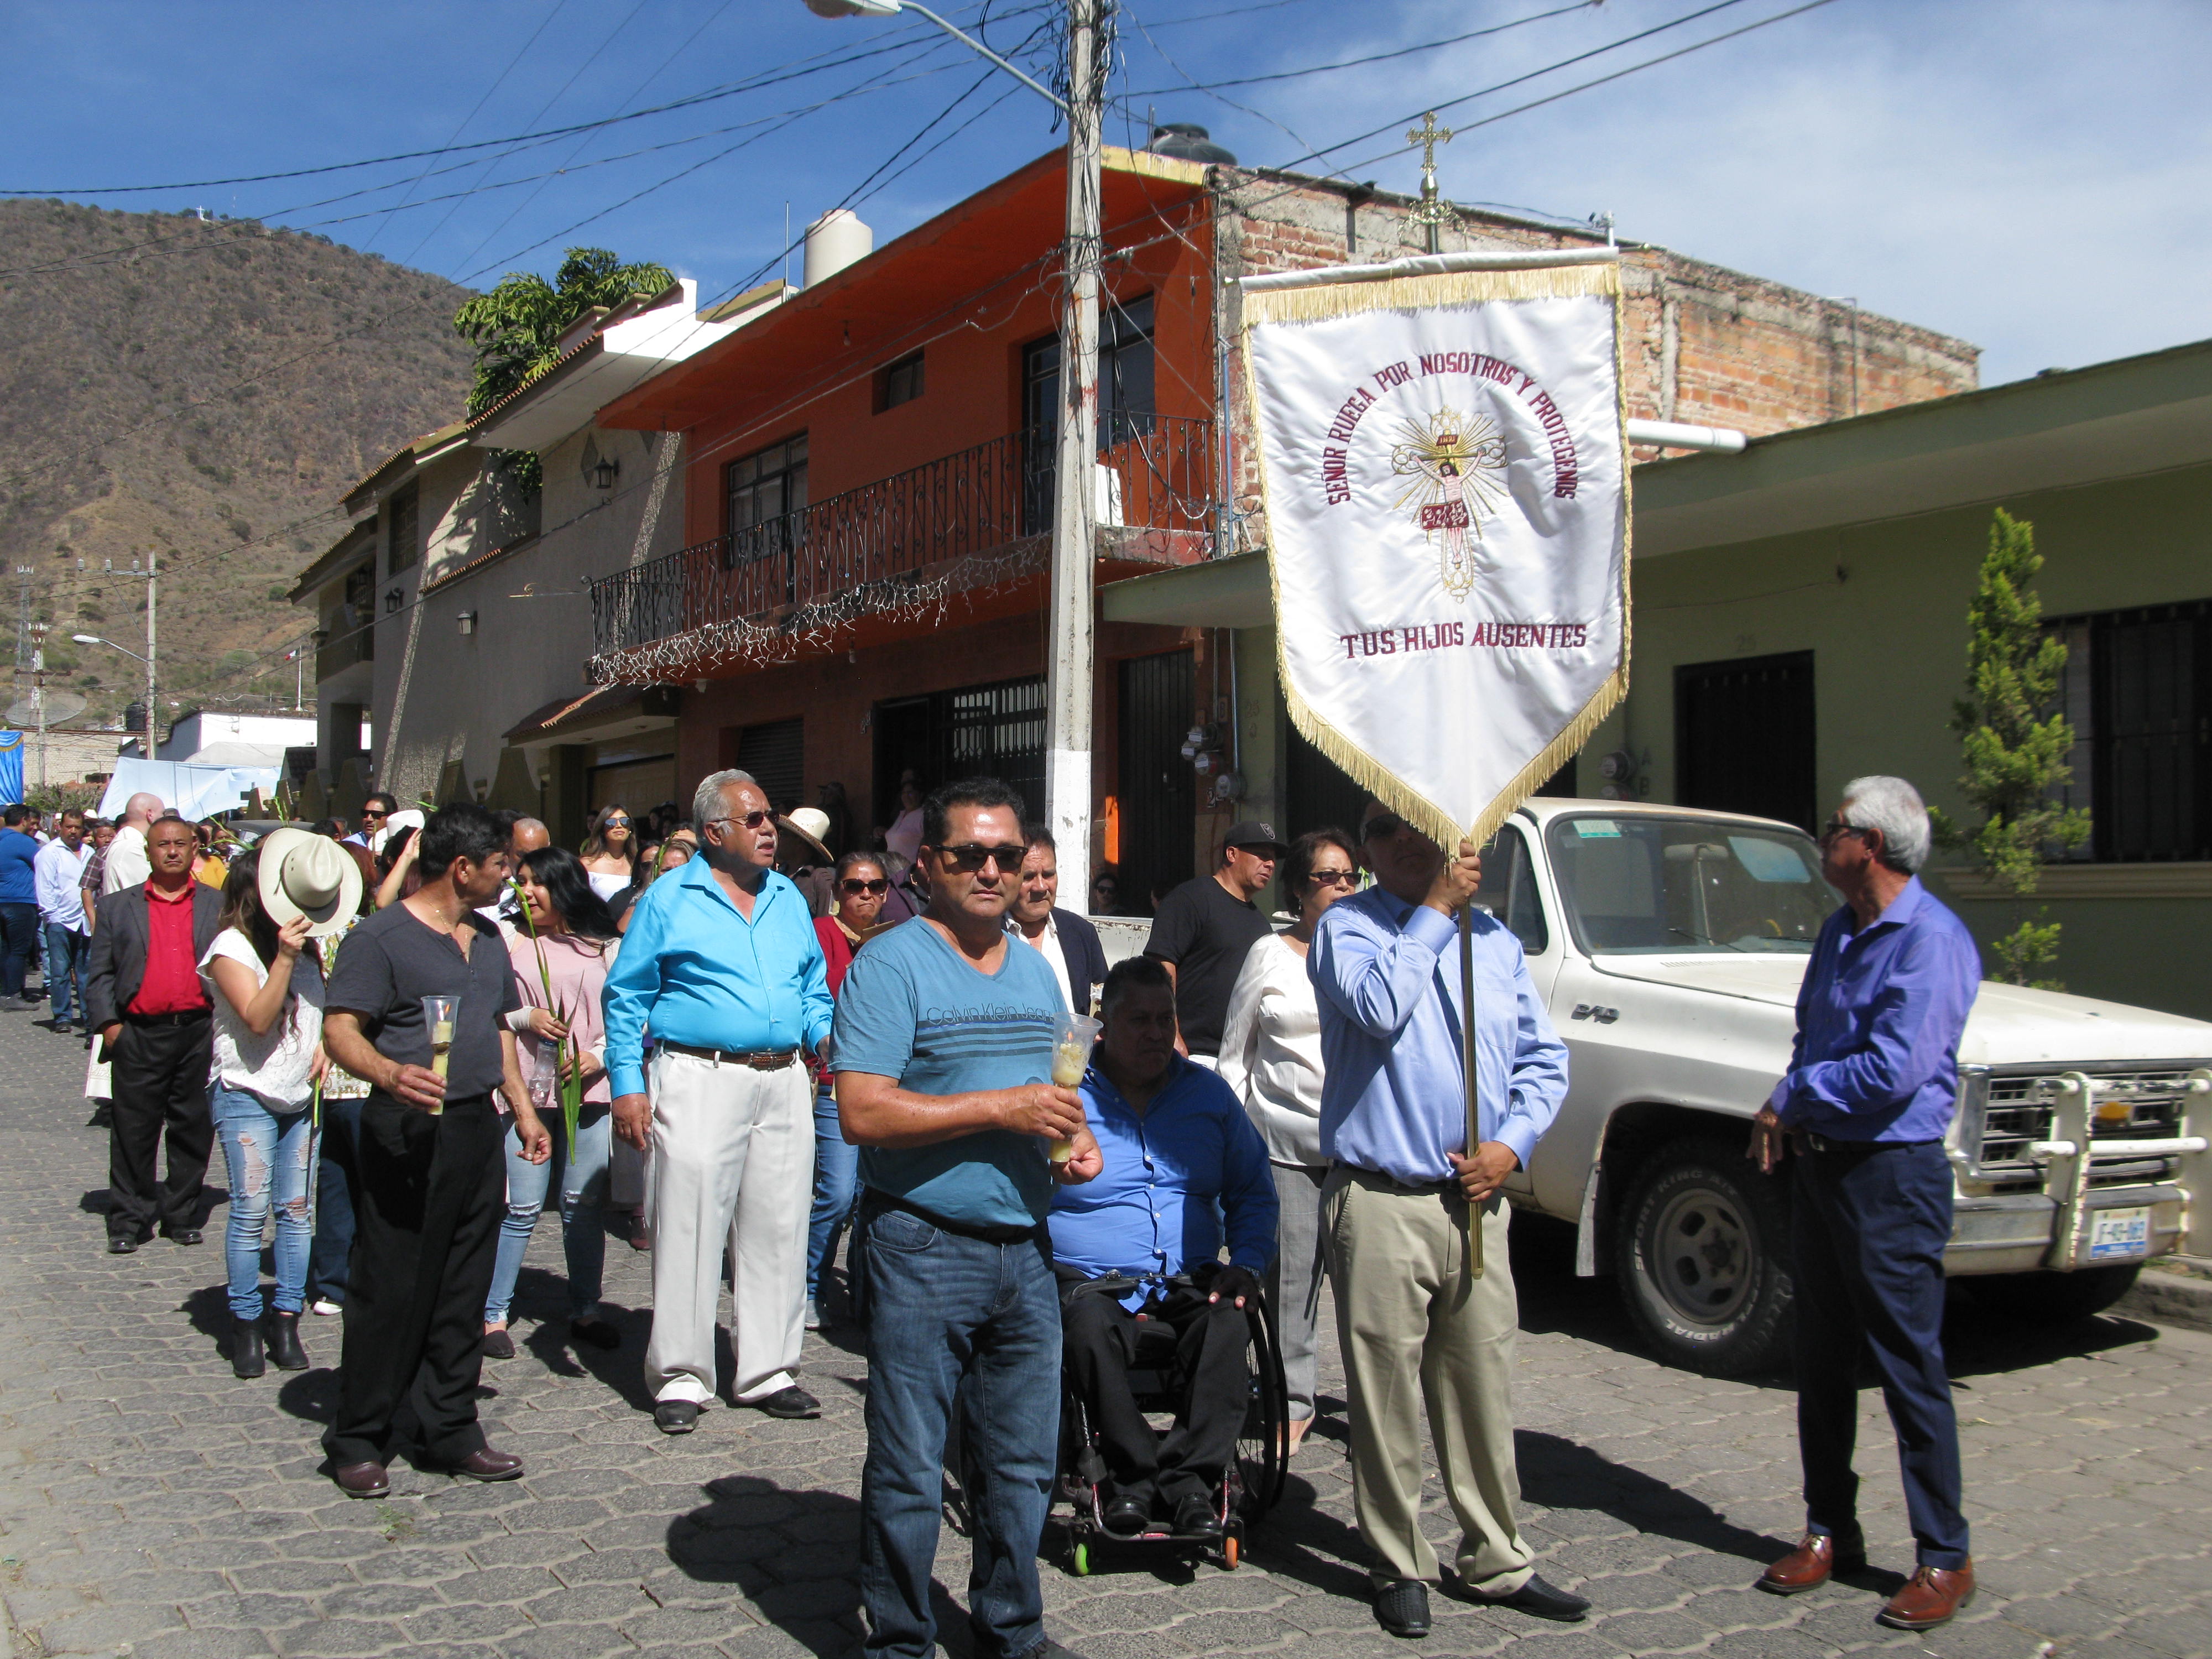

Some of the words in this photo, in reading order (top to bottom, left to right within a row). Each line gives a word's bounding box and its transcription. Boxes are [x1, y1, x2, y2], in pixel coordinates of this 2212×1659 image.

[1373, 361, 1415, 393] POR
[1418, 352, 1518, 385] NOSOTROS
[1516, 374, 1535, 396] Y
[1328, 387, 1378, 444] RUEGA
[1527, 389, 1578, 499] PROTEGENOS
[1321, 446, 1350, 505] SEÑOR
[1340, 630, 1396, 659] TUS
[1404, 621, 1464, 652] HIJOS
[1470, 622, 1587, 649] AUSENTES
[927, 1005, 979, 1025] Calvin
[982, 1002, 1018, 1020] Klein
